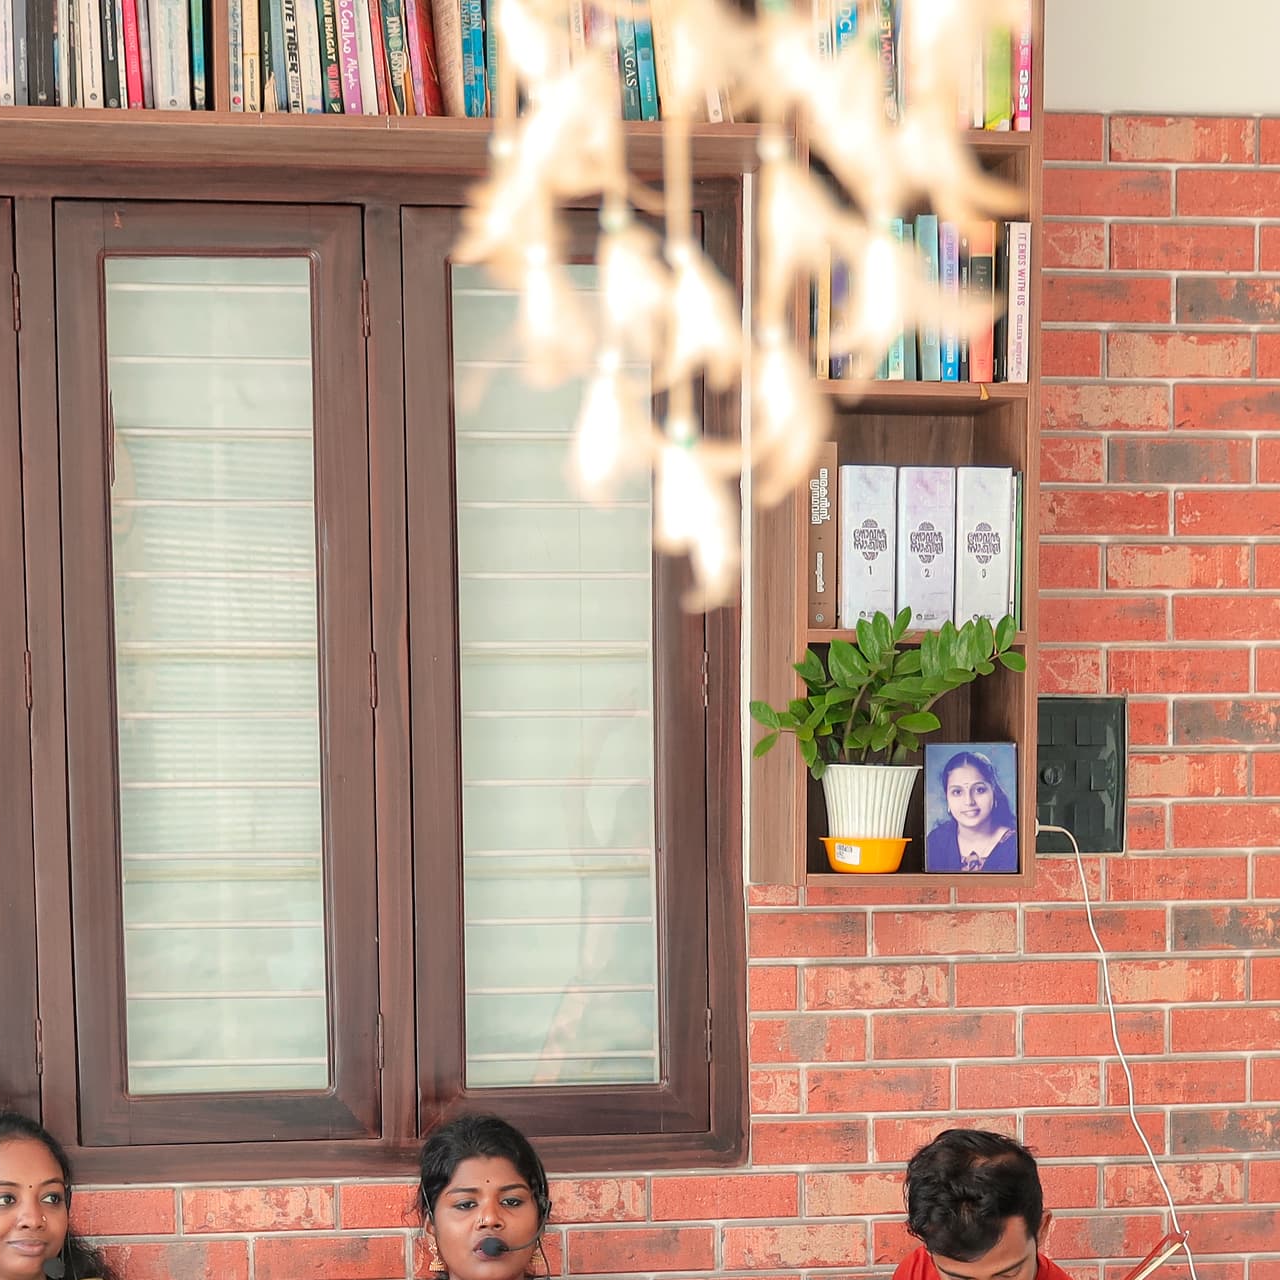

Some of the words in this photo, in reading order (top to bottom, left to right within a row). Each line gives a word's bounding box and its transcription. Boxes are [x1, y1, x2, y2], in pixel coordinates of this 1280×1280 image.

[470, 0, 481, 29] JOHN
[324, 17, 335, 62] BHAGAT
[341, 10, 354, 54] Coelho
[287, 26, 298, 73] TIGER
[623, 37, 637, 87] NAGAS
[344, 58, 357, 90] Aleph
[390, 51, 403, 86] GRISHAM
[1019, 69, 1030, 111] PSC
[1018, 244, 1026, 265] ENDS
[1017, 268, 1026, 292] WITH
[1017, 295, 1025, 306] US
[868, 565, 872, 575] 1
[925, 569, 930, 577] 2
